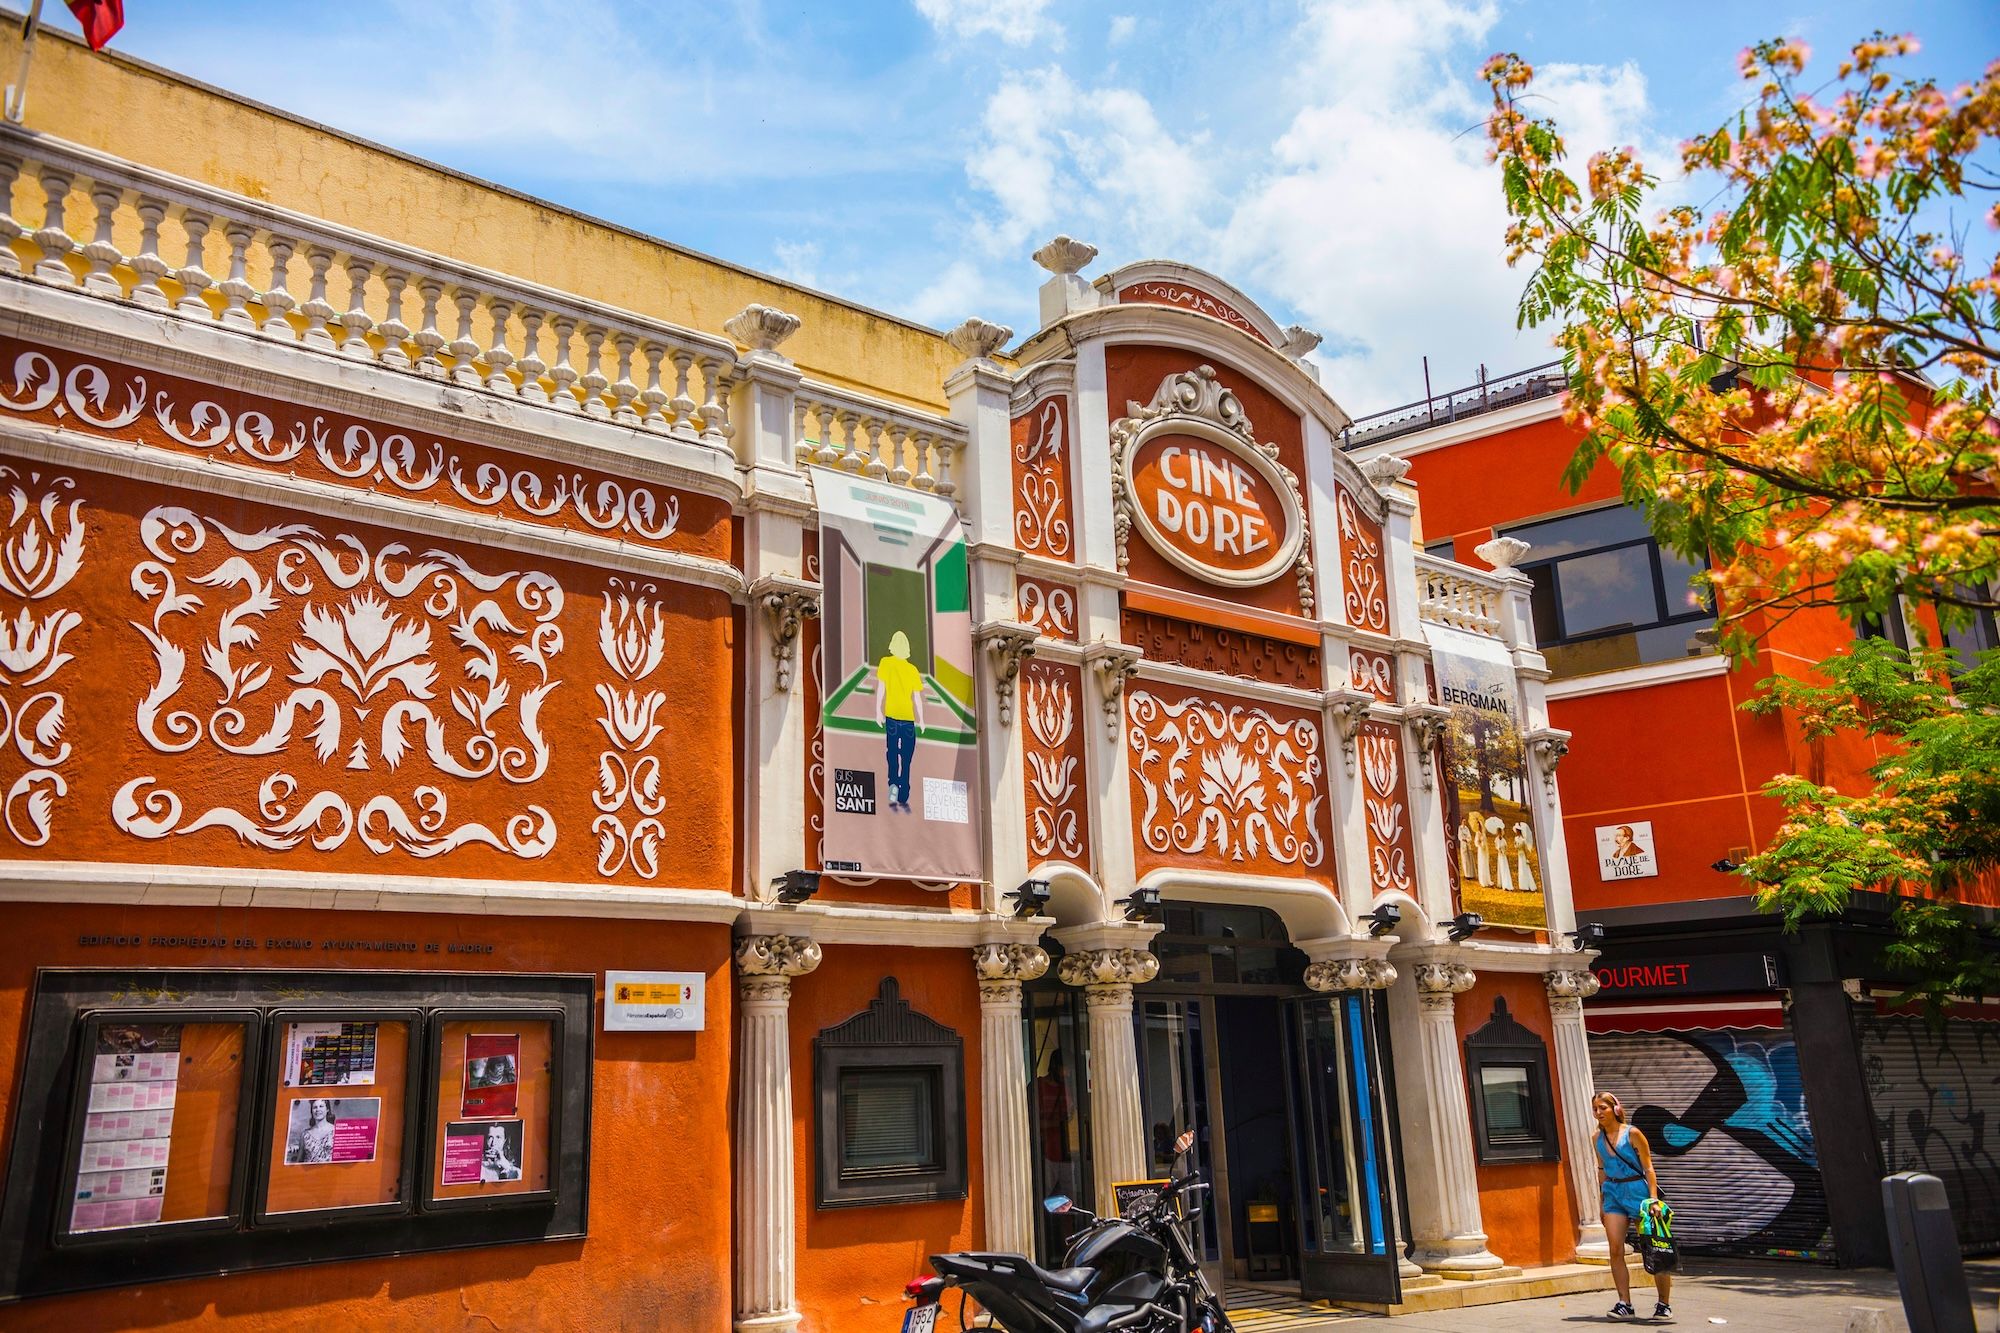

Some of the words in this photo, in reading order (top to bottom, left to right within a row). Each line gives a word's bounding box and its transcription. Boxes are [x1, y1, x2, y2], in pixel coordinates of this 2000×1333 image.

[1160, 446, 1260, 511] CINE
[1157, 488, 1269, 556] DORE
[1122, 610, 1320, 664] FILMOTECA
[1135, 631, 1308, 680] ESPAÑOLA
[1443, 686, 1507, 714] BERGMAN
[835, 769, 854, 782] GUS
[836, 783, 863, 798] VAN
[836, 797, 875, 813] SANT
[926, 805, 967, 821] BELLOS
[80, 935, 142, 946] EDIFICIO
[151, 936, 228, 948] PROPIEDAD
[234, 937, 258, 948] DEL
[267, 938, 313, 949] EXCMO
[321, 939, 418, 952] AYUNTAMIENTO
[424, 942, 440, 953] DE
[447, 943, 495, 954] MADRID
[1598, 964, 1690, 988] OURMET
[912, 1308, 933, 1326] 1552
